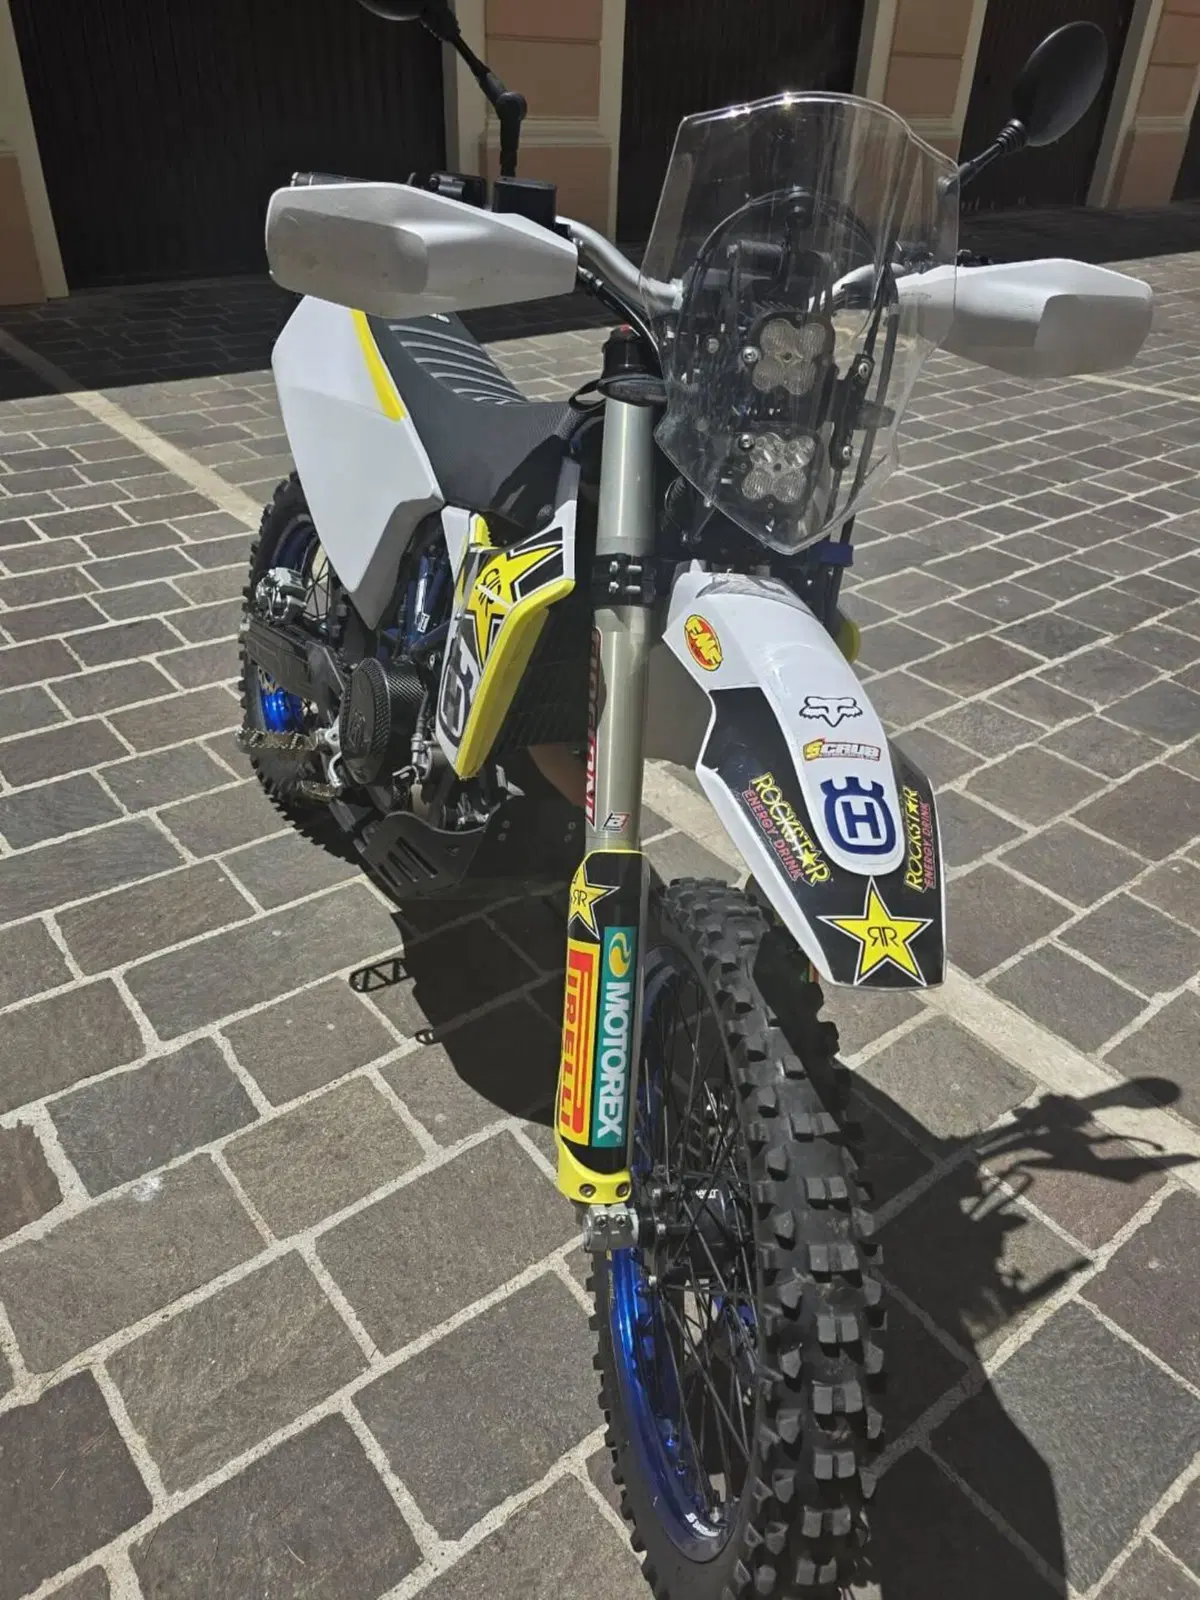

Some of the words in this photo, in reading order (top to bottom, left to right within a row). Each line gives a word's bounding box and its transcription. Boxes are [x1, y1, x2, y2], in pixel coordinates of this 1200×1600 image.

[685, 616, 724, 667] FMF
[803, 739, 881, 760] SCRUB
[743, 789, 779, 835] ENERGY
[773, 839, 804, 879] DRINK
[841, 801, 881, 839] H
[920, 802, 932, 837] DRINK
[922, 839, 935, 889] ENERGY
[561, 949, 593, 1134] PIRELLI
[597, 981, 631, 1139] MOTOREX
